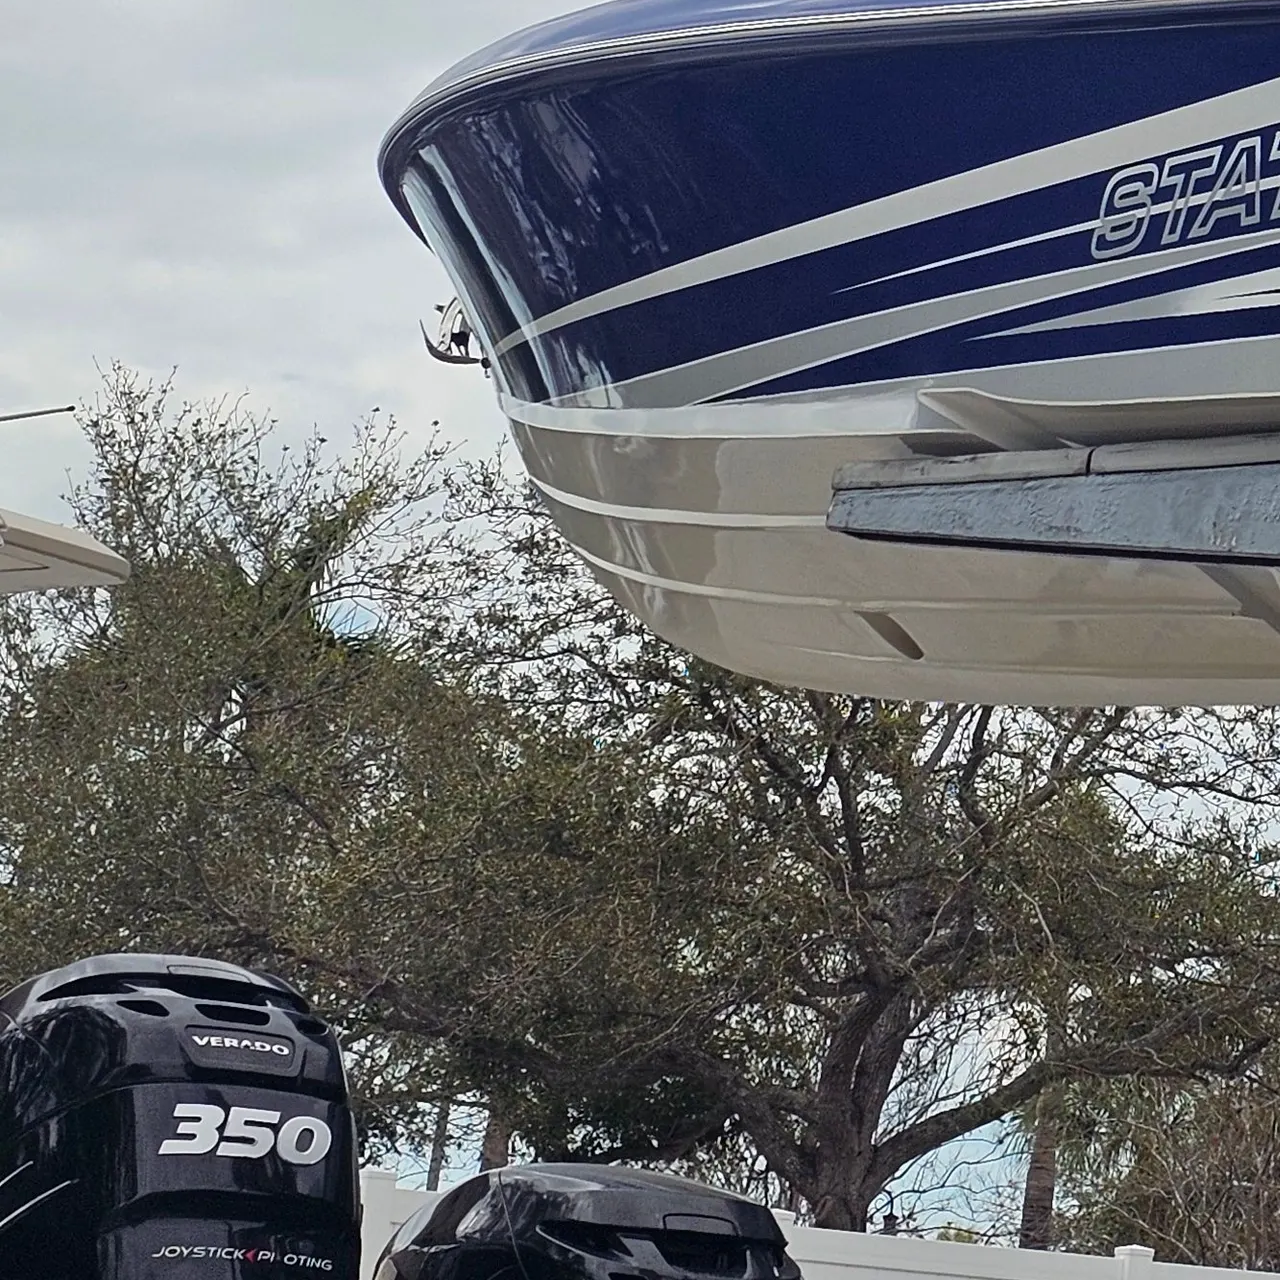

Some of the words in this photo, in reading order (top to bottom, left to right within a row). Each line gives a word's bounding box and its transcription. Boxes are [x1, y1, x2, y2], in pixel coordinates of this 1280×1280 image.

[191, 1035, 291, 1056] VERADO
[158, 1103, 332, 1165] 350
[152, 1245, 246, 1261] JOYSTICK
[257, 1250, 333, 1271] PIOTING
